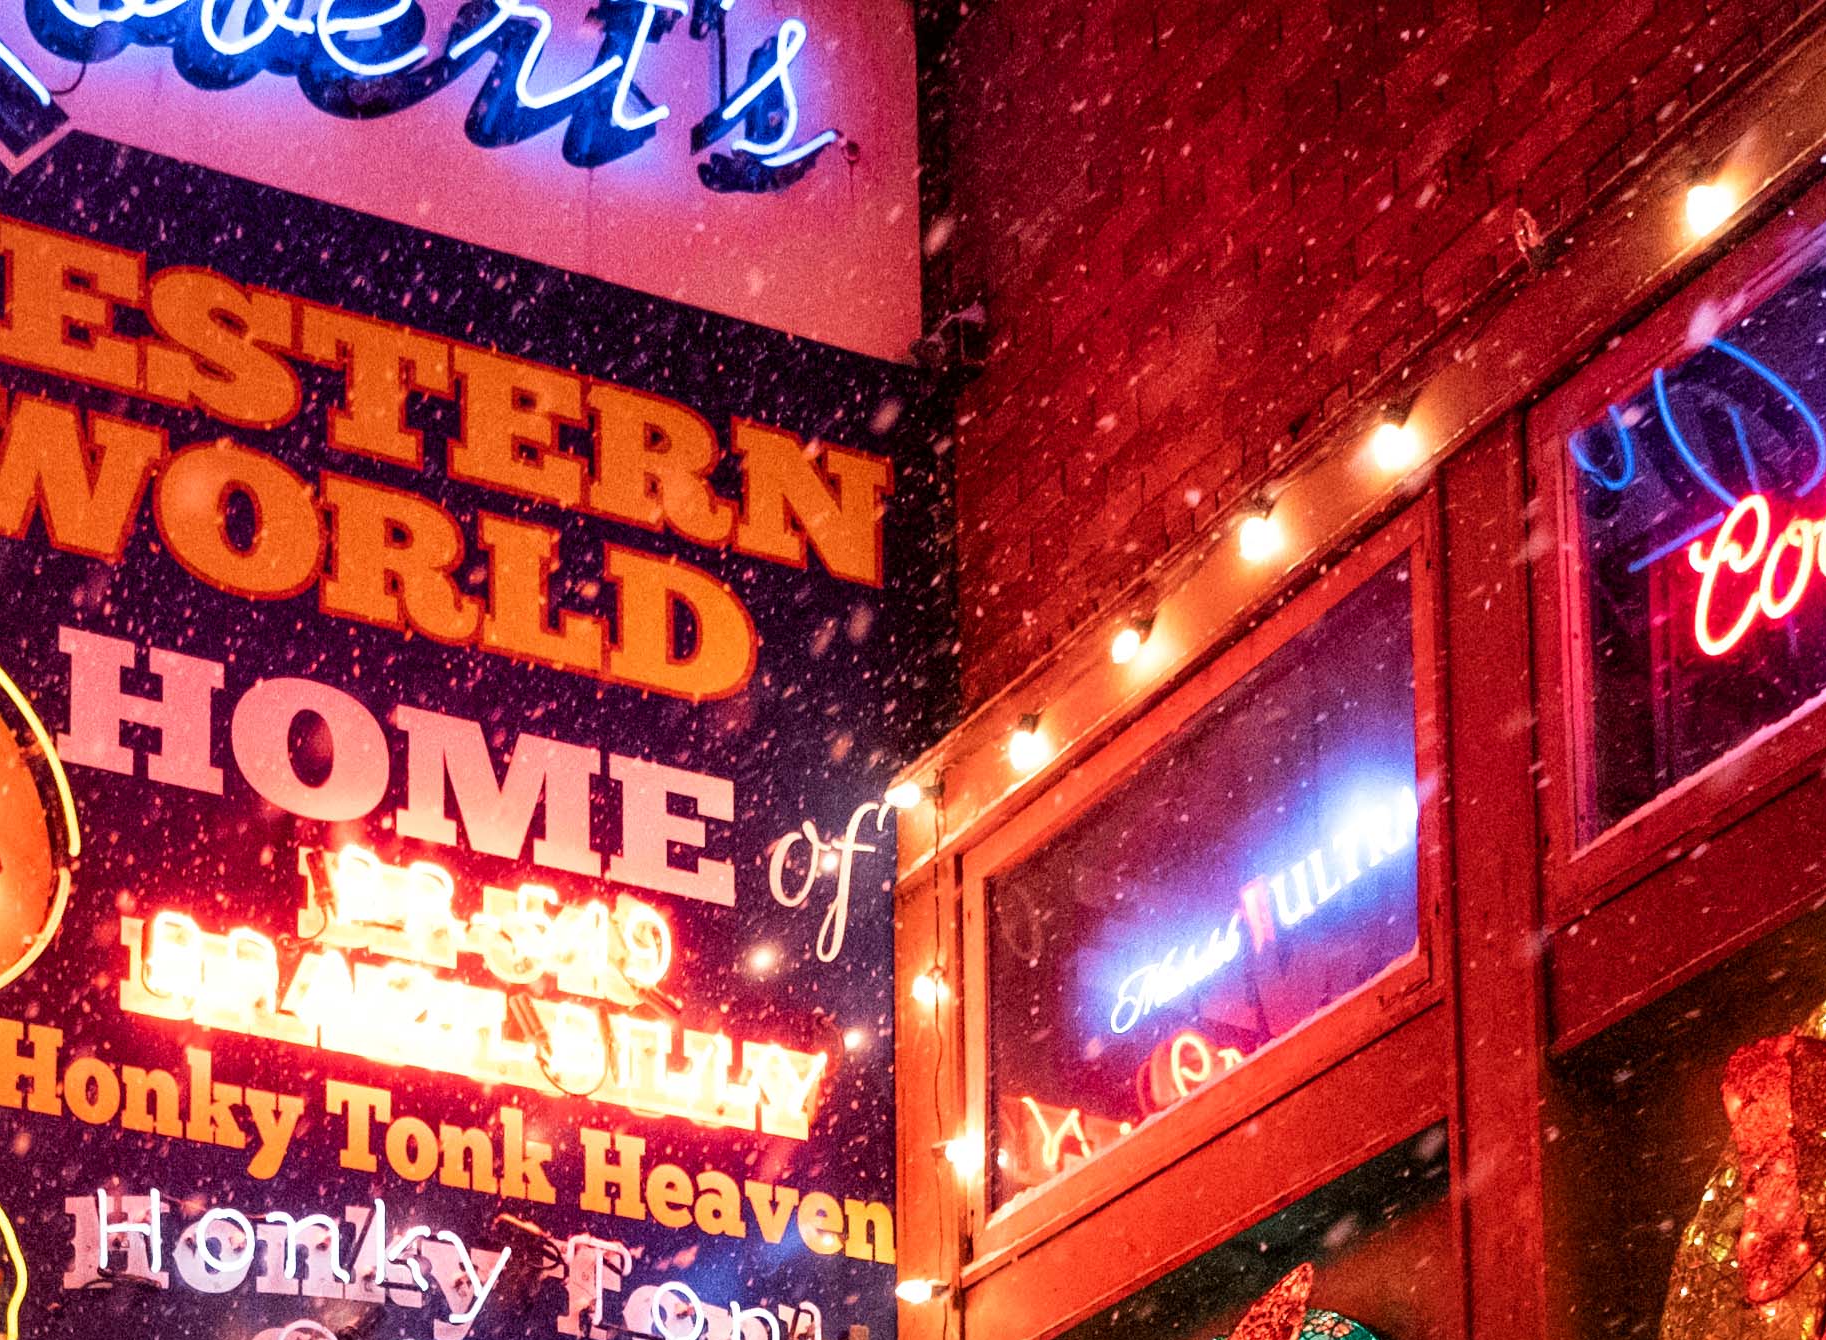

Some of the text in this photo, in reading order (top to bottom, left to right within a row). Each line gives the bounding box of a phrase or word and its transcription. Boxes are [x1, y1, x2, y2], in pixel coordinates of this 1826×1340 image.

[58, 626, 893, 963] HOME of
[325, 1077, 558, 1206] Tonk
[578, 1127, 897, 1266] Heaven
